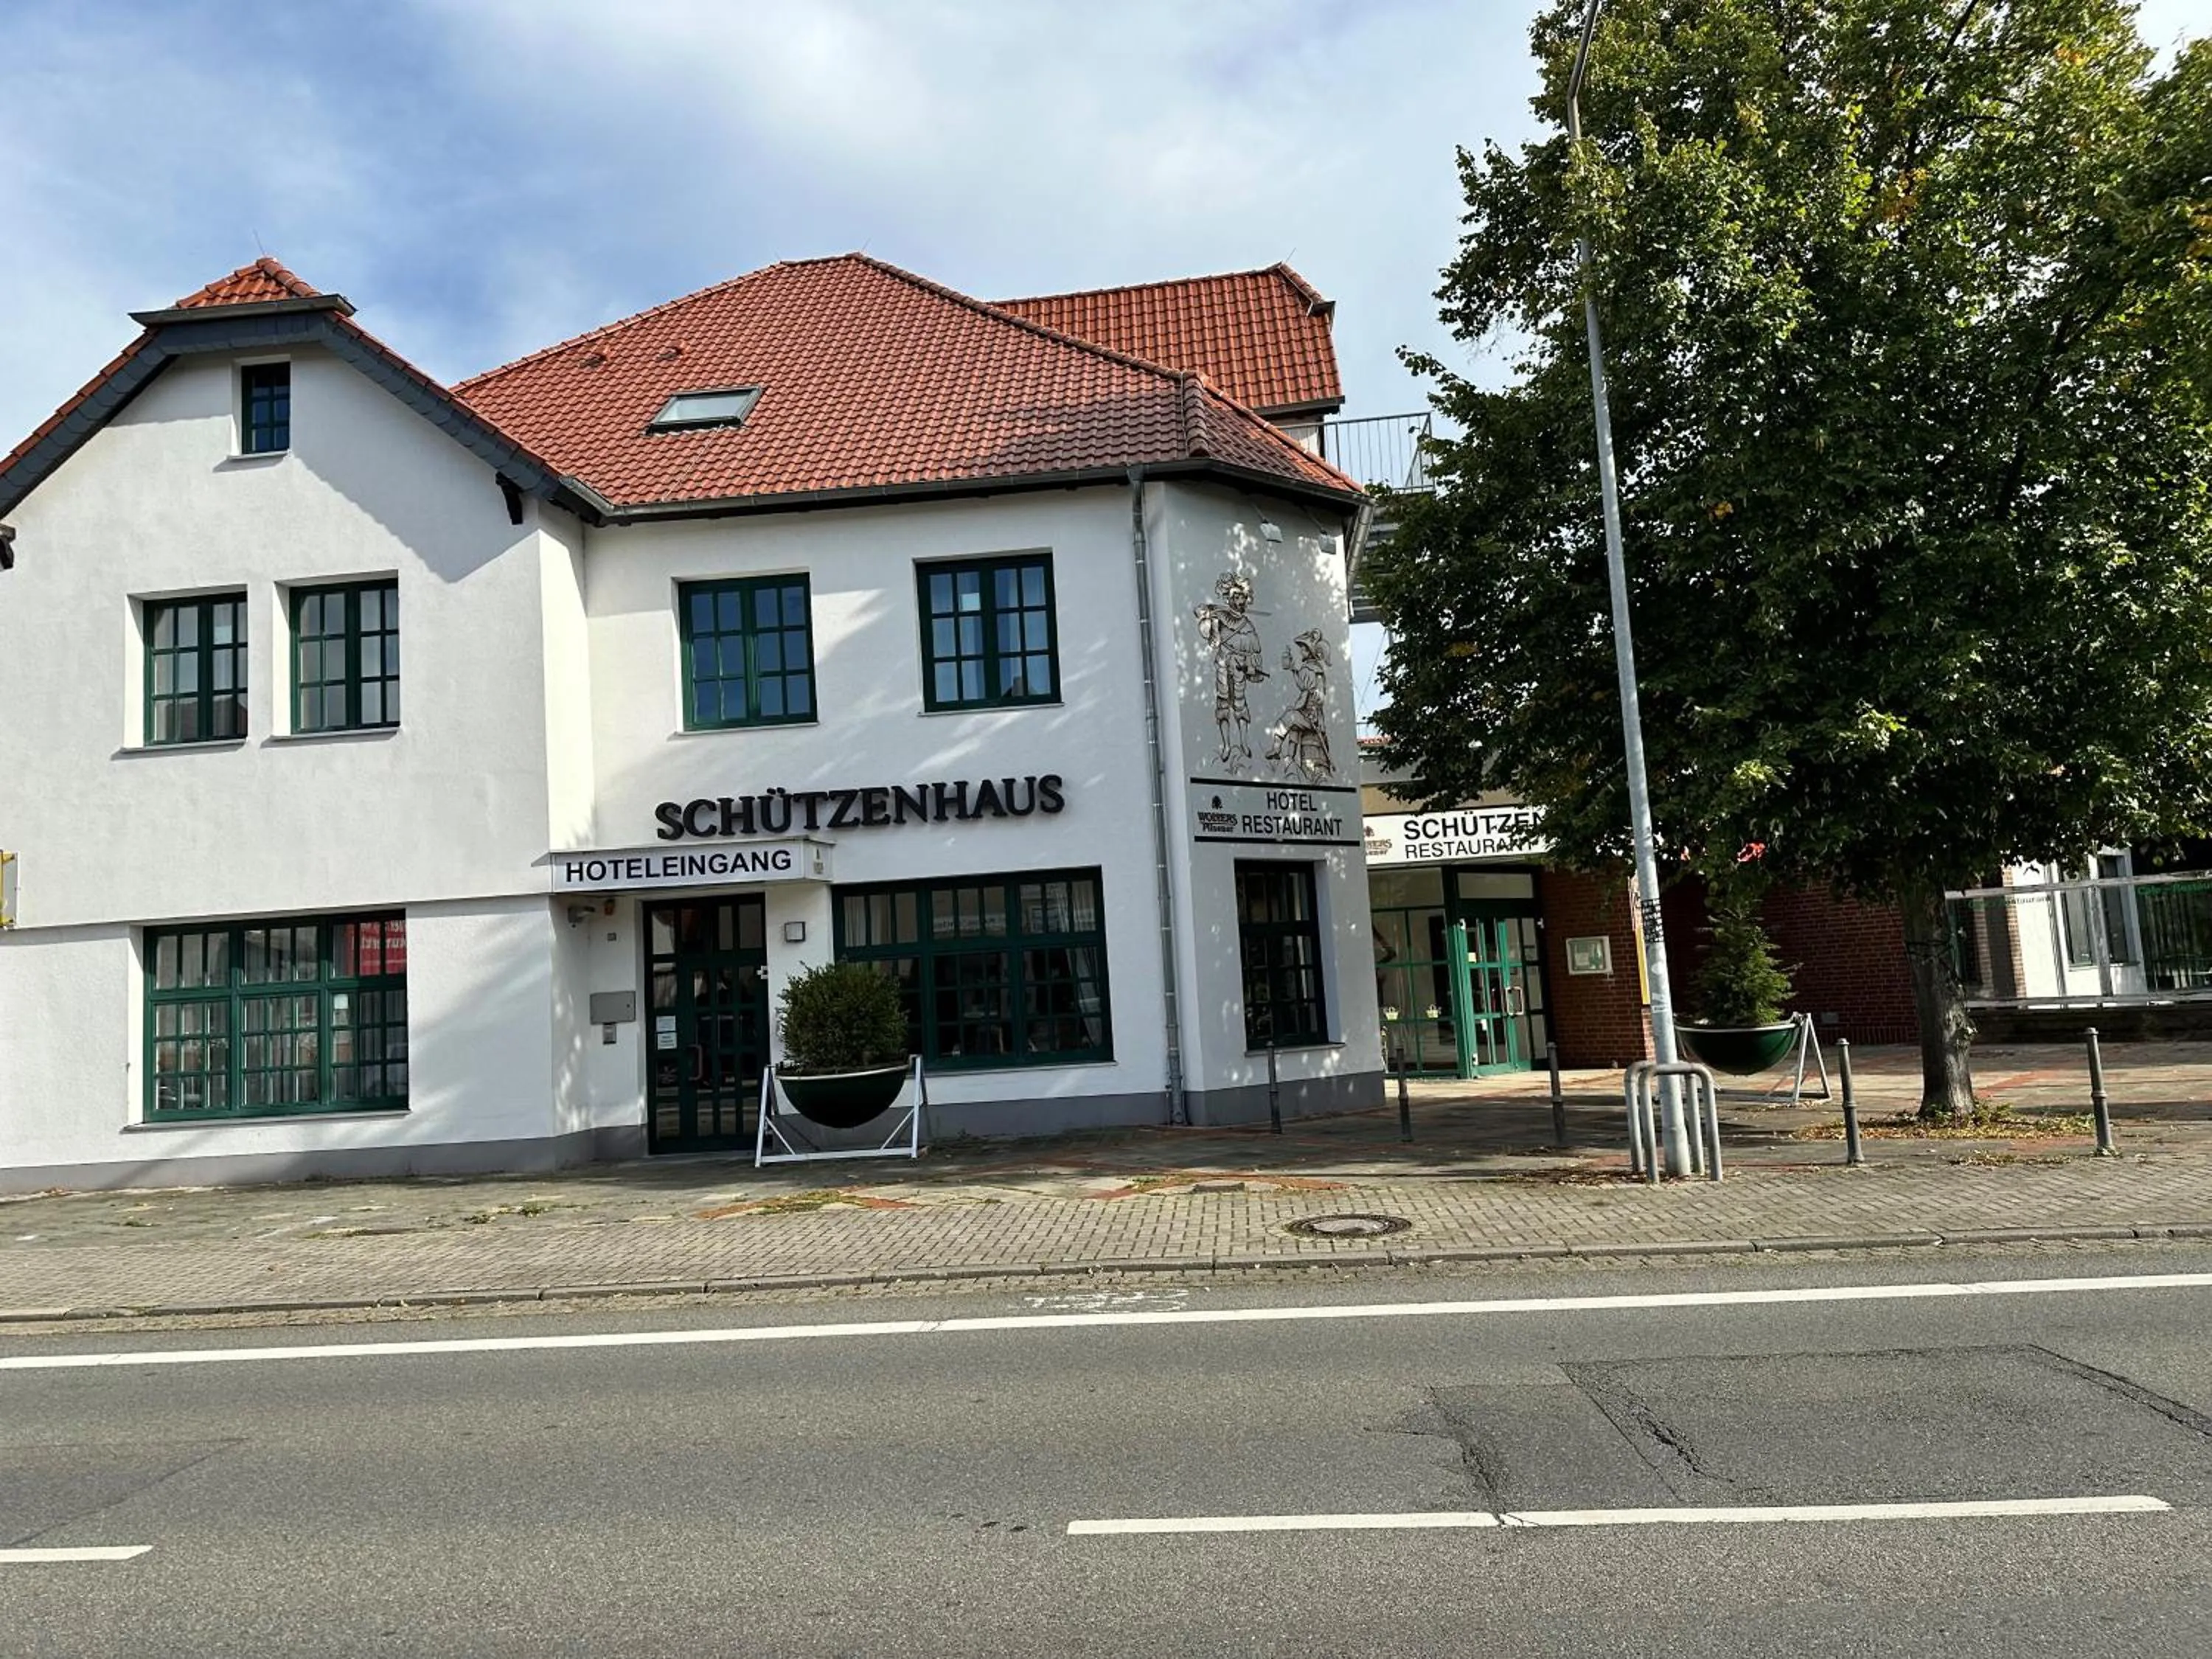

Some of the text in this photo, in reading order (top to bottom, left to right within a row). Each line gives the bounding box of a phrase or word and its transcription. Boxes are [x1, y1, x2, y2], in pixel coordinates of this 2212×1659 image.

[655, 774, 1065, 841] SCHÜTZENHAUS
[1266, 792, 1318, 812] HOTEL
[1242, 815, 1343, 836] RESTAURANT
[566, 849, 792, 883] HOTELEINGANG
